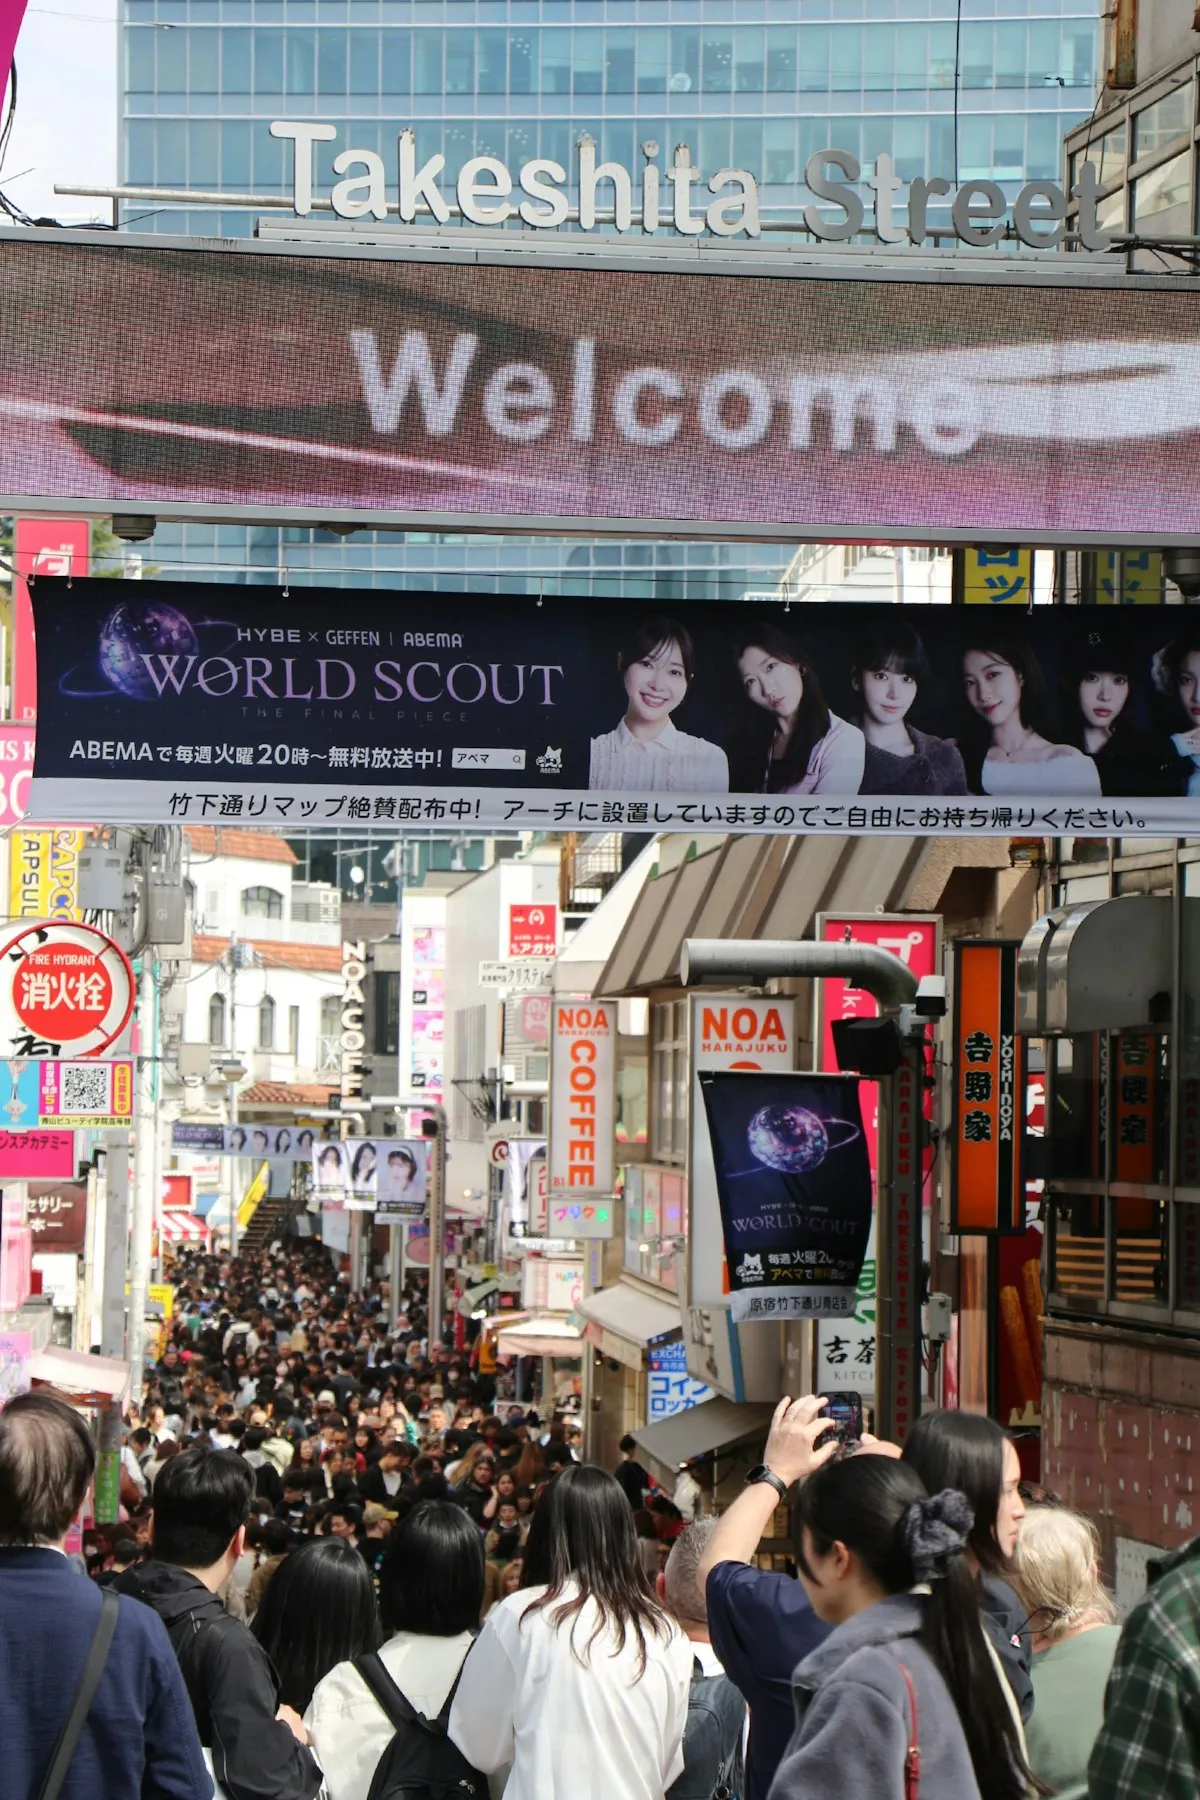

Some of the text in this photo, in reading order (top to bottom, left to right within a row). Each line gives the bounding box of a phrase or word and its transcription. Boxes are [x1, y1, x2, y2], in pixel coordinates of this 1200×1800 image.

[269, 121, 1112, 252] Takeshita Street
[350, 329, 982, 458] Welcome
[237, 628, 301, 643] HYBE
[326, 630, 380, 646] GEFFEN
[403, 631, 464, 648] ABEMA
[139, 653, 565, 705] WORLD SCOUT
[241, 707, 468, 722] THE FINAL PIECE
[457, 752, 490, 764] アベマ
[28, 953, 97, 966] FIRE HYDRANT
[341, 940, 367, 1003] NOA
[20, 971, 107, 1012] 消火栓
[557, 1008, 609, 1029] NOA
[702, 1007, 787, 1041] NOA
[702, 1043, 788, 1053] HARAJUKU
[1000, 1035, 1015, 1141] YOSHINOYA
[567, 1039, 597, 1187] COFFEE
[732, 1212, 802, 1233] WORLD
[895, 1193, 911, 1330] TAKESHITA
[750, 1296, 848, 1312] 原宿竹下通り商店会
